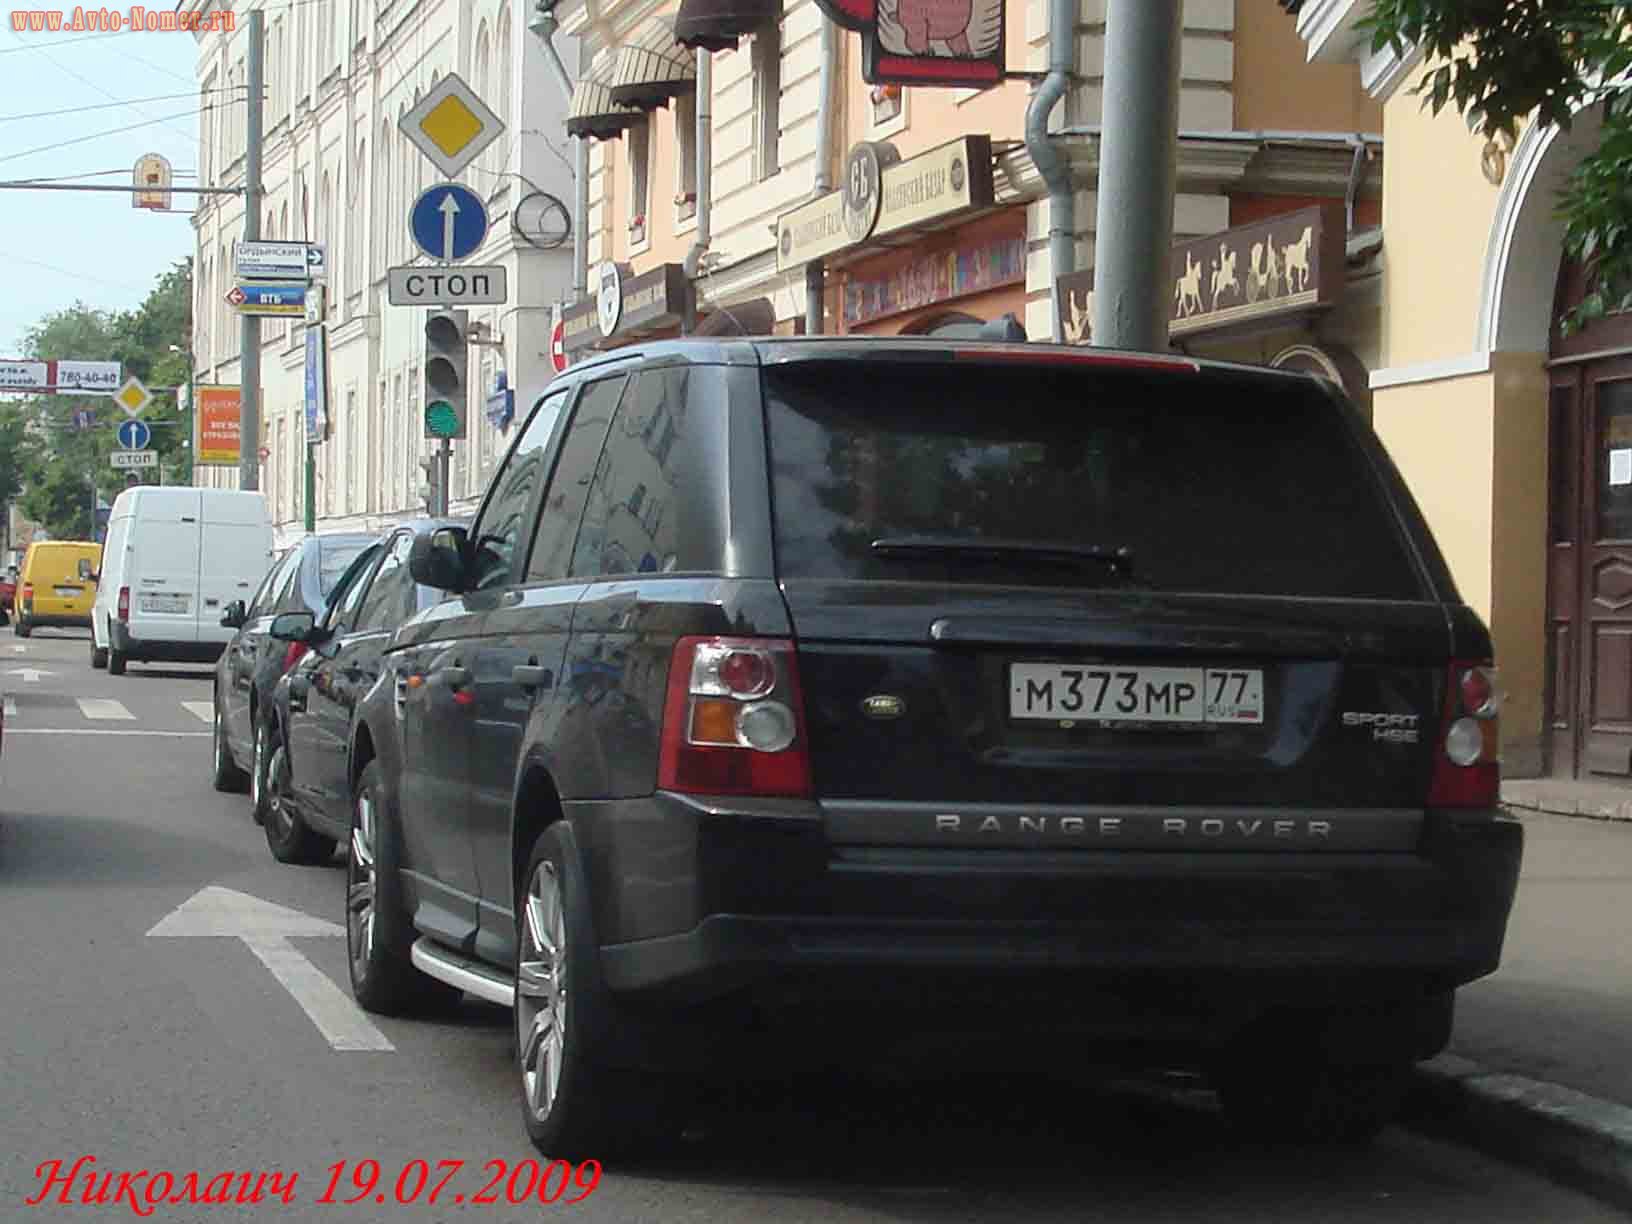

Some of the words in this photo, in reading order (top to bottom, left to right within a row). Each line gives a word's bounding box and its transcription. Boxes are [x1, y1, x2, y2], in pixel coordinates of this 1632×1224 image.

[406, 274, 489, 297] СТОП
[118, 455, 151, 465] СТОП
[1026, 670, 1196, 715] М373МР
[1210, 671, 1249, 705] 77
[1342, 711, 1418, 727] SPORT
[1374, 728, 1418, 744] HSE
[935, 814, 1123, 835] RANGE
[1161, 818, 1331, 839] ROVER
